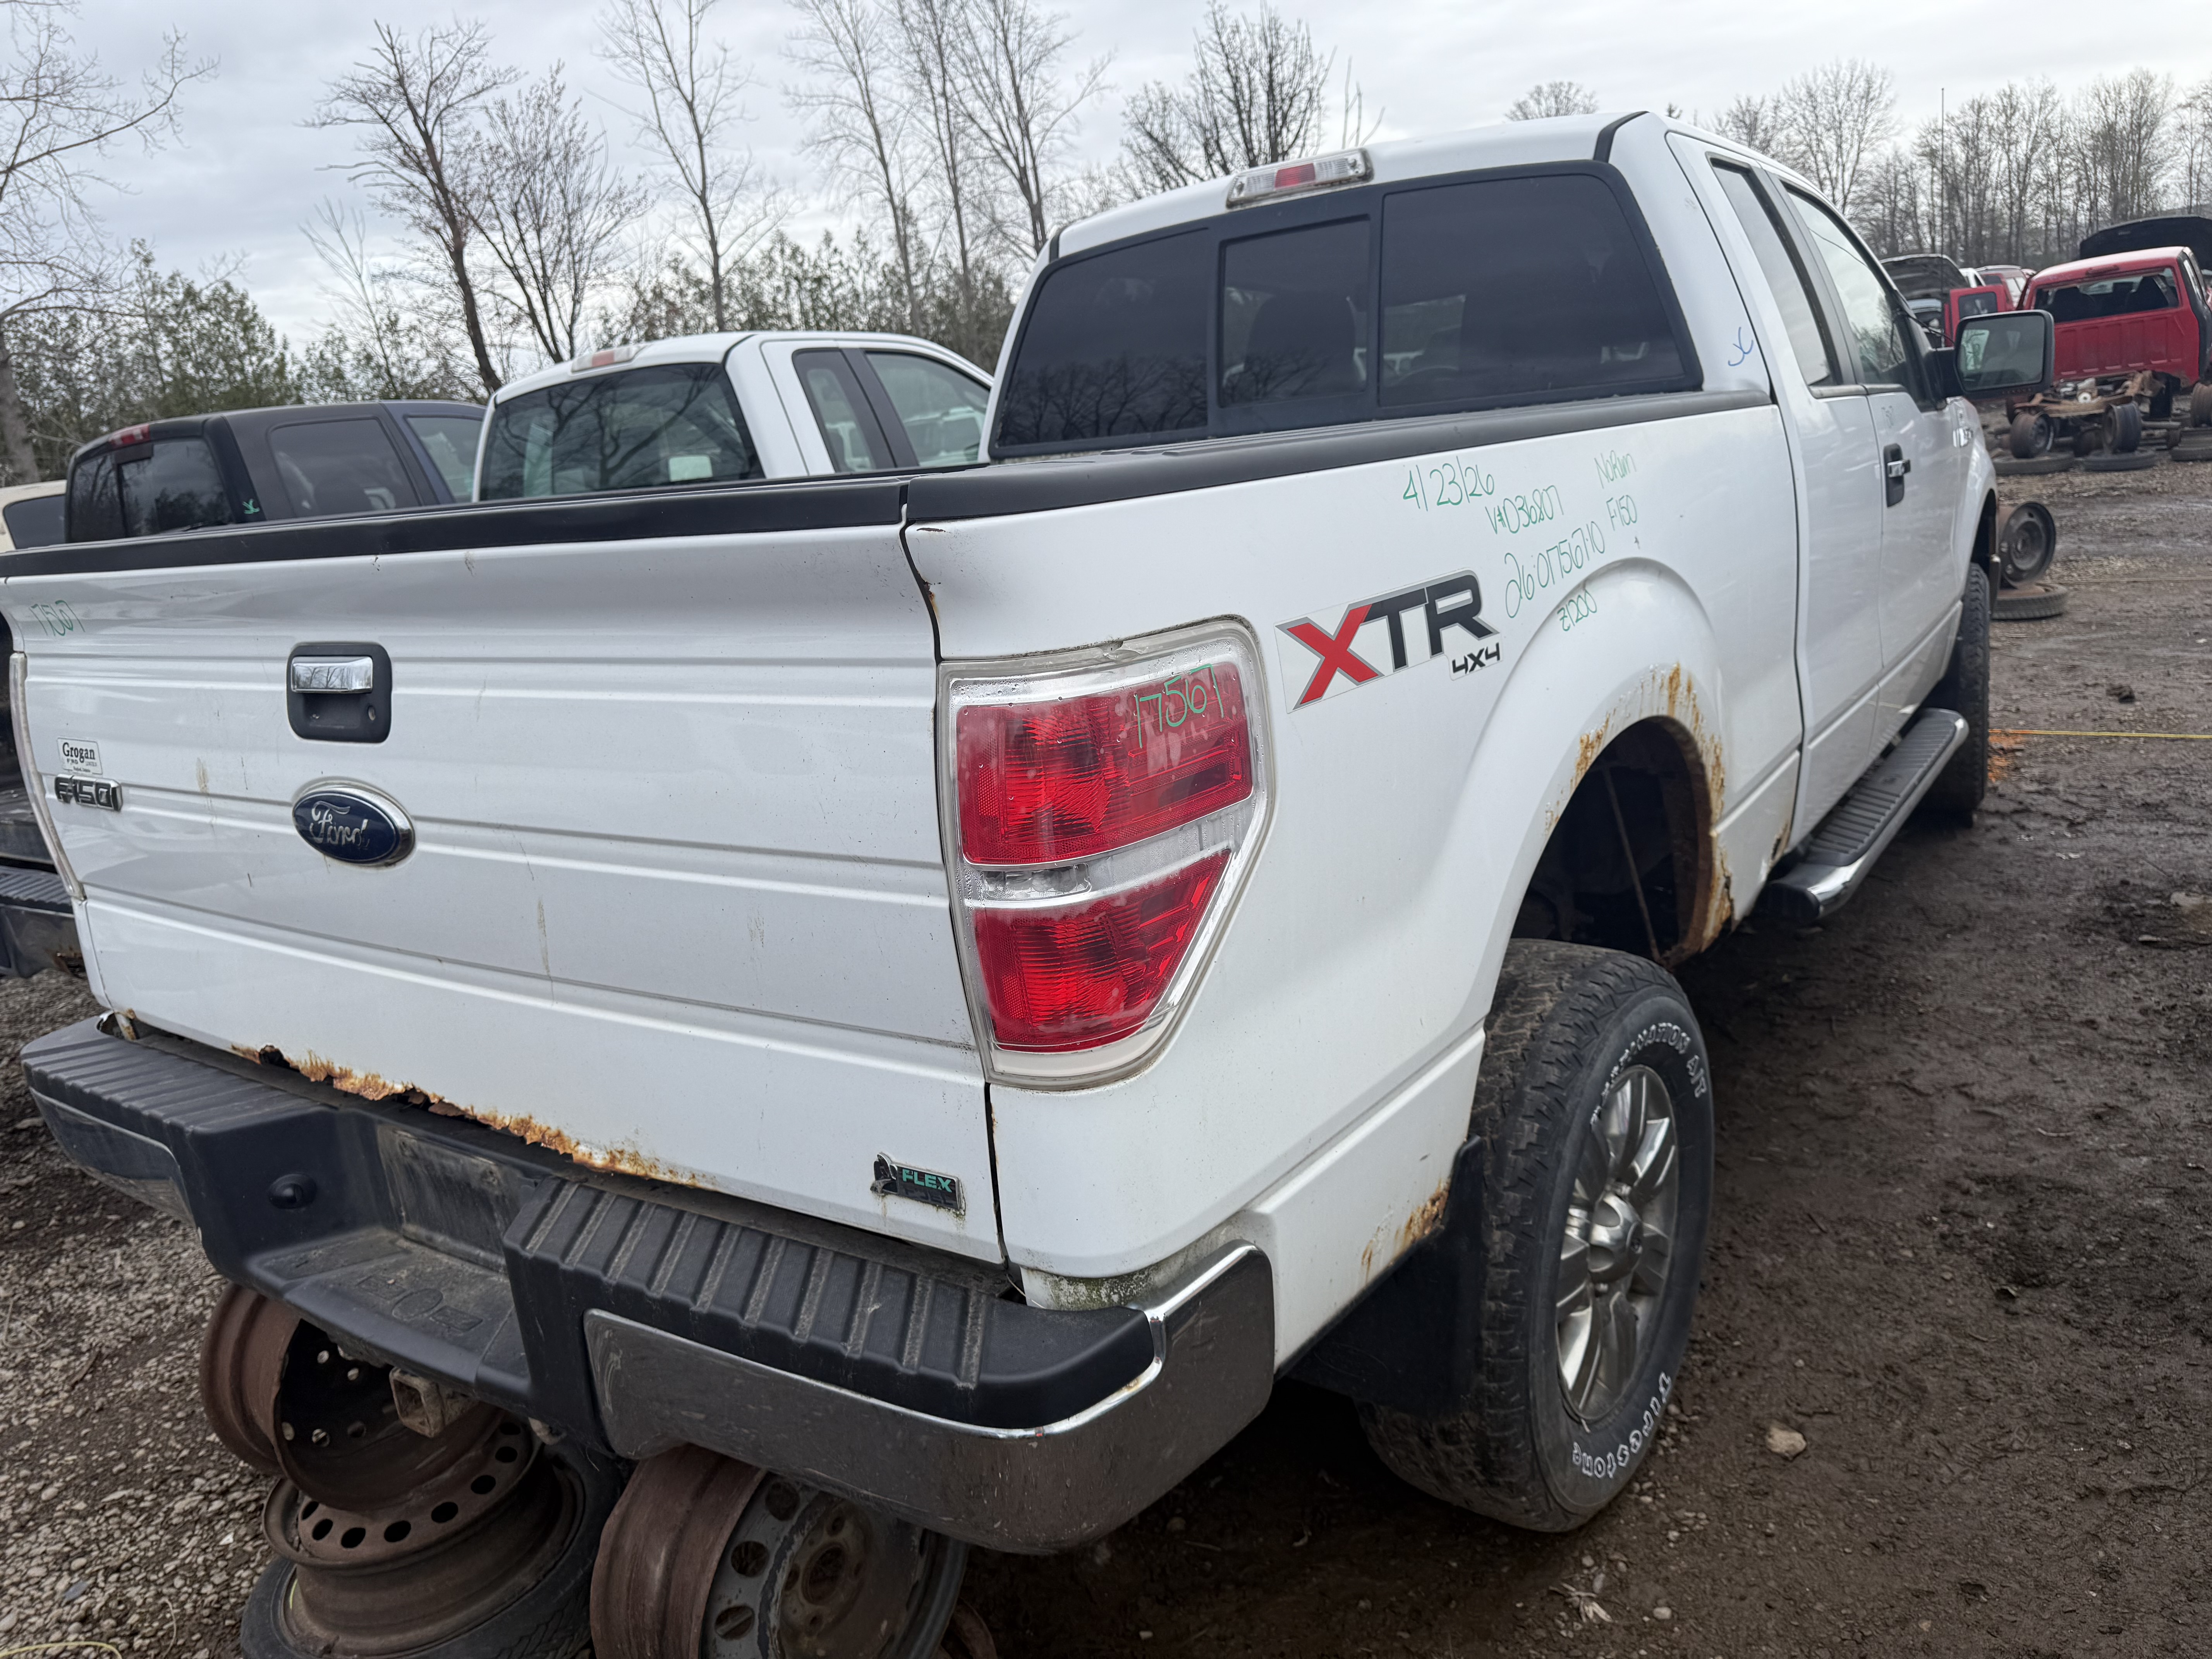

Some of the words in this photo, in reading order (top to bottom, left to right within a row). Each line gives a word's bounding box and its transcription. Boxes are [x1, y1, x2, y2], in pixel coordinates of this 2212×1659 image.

[1275, 570, 1501, 710] XTR
[1135, 663, 1224, 749] 17567
[62, 742, 96, 763] Grogan
[310, 800, 370, 849] Ford
[902, 1169, 953, 1193] FLEX
